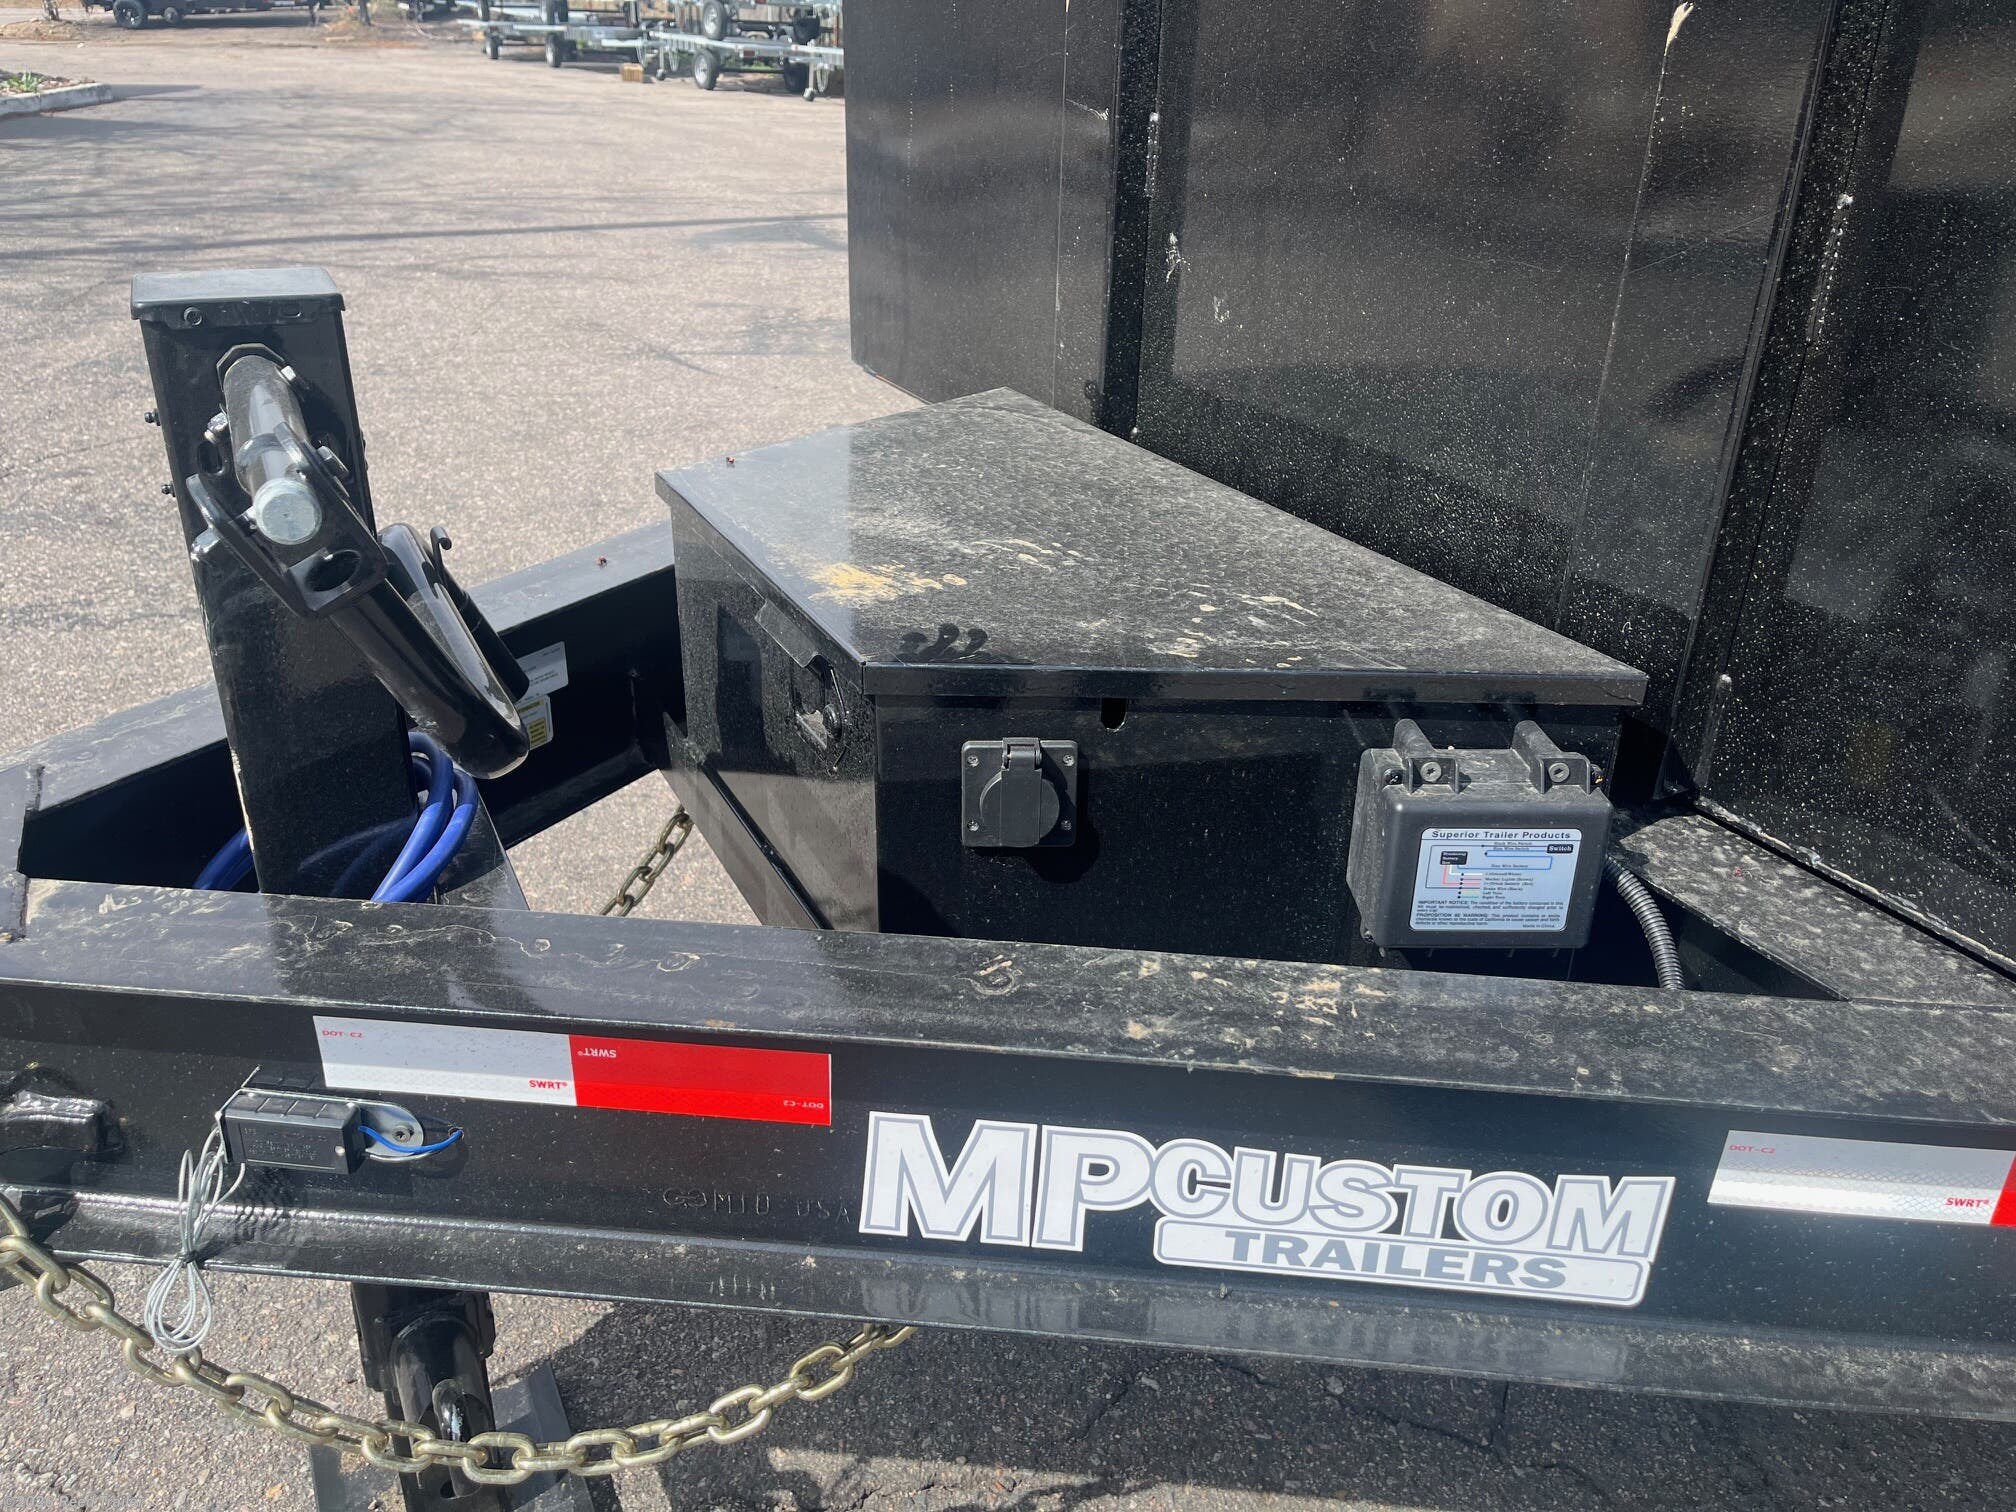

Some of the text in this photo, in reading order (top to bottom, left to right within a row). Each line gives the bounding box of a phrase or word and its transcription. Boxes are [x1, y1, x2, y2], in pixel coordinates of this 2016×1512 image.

[1431, 831, 1571, 840] Superior Trailer Products
[1224, 1229, 1568, 1290] TRAILERS
